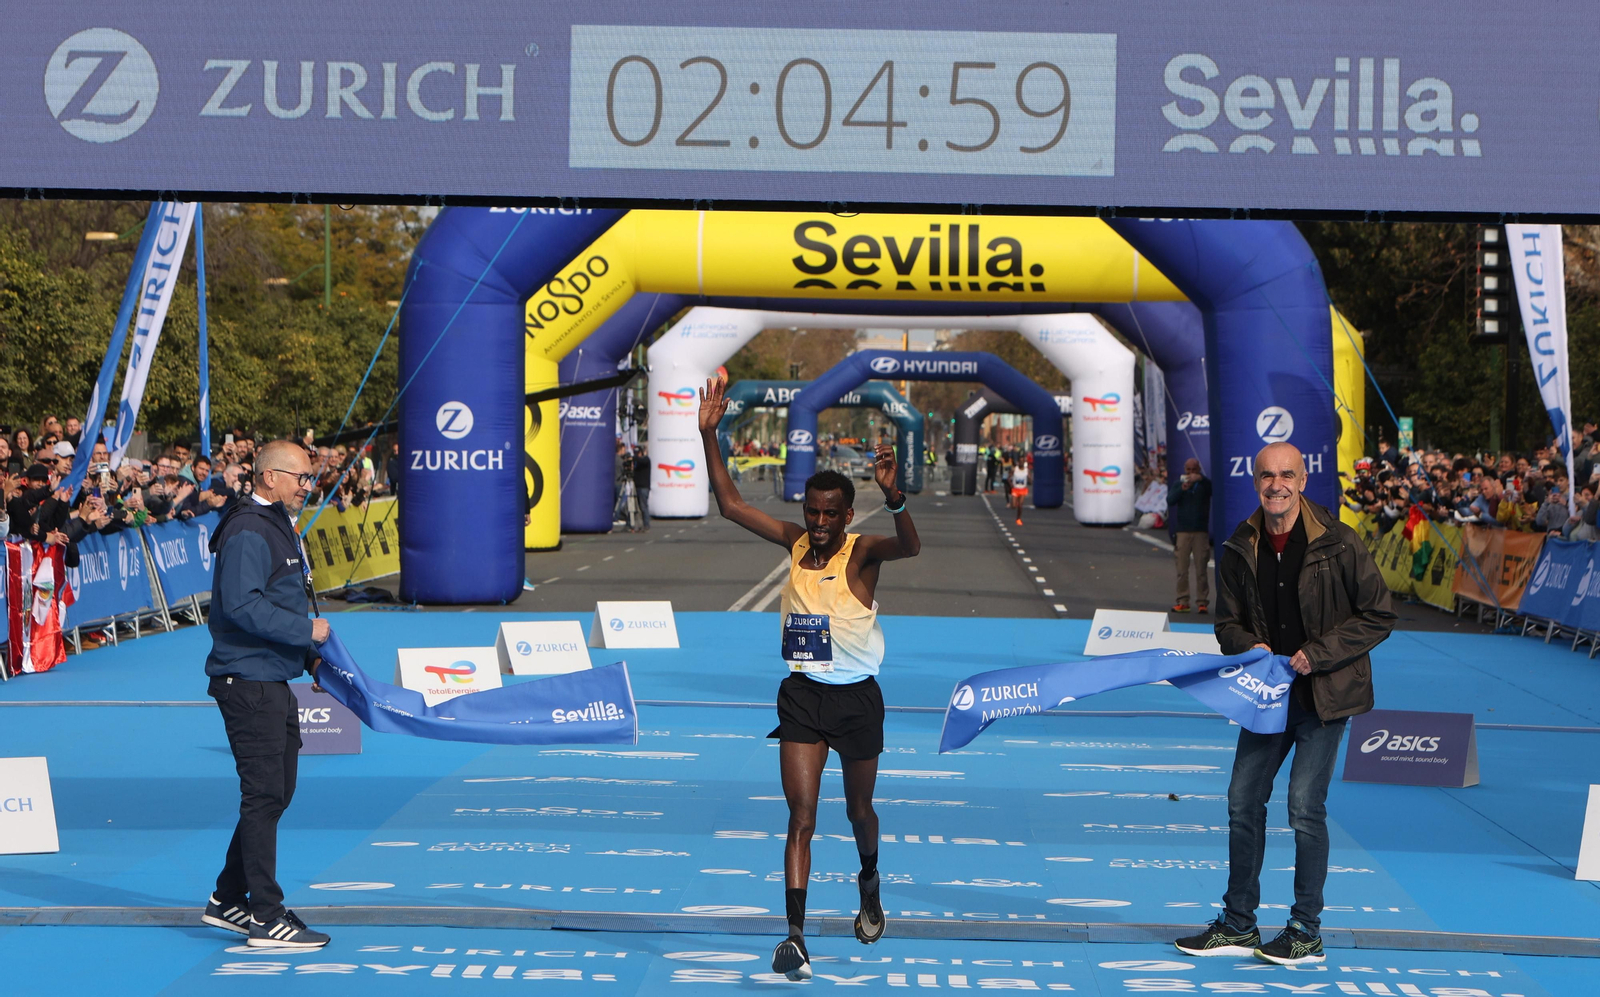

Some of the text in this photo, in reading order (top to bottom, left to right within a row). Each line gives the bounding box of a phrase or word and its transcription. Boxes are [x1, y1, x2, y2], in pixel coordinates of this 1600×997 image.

[199, 59, 516, 121] ZURICH
[606, 54, 1072, 153] 02:04:59
[792, 220, 1044, 278] Sevilla.
[903, 360, 977, 374] HYUNDAI
[882, 402, 908, 414] ABC
[410, 450, 504, 471] ZURICH
[1229, 453, 1323, 477] ZUH
[161, 538, 189, 569] ZURICH
[79, 550, 110, 584] ZURICH
[627, 620, 667, 629] ZURICH
[794, 617, 822, 626] ZURICH
[797, 636, 806, 646] 18
[1114, 630, 1154, 640] ZURICH
[535, 643, 578, 652] ZURICH
[980, 682, 1038, 702] ZURICH
[551, 700, 625, 722] Sevilla.
[1386, 735, 1441, 752] asics
[1433, 757, 1449, 765] body
[425, 883, 662, 894] ZURICH
[357, 945, 628, 958] ZURICH
[809, 956, 1065, 967] ZURICH
[211, 962, 617, 981] Sevilla.
[1233, 964, 1502, 977] ZURICH
[670, 969, 1076, 990] Sevilla.
